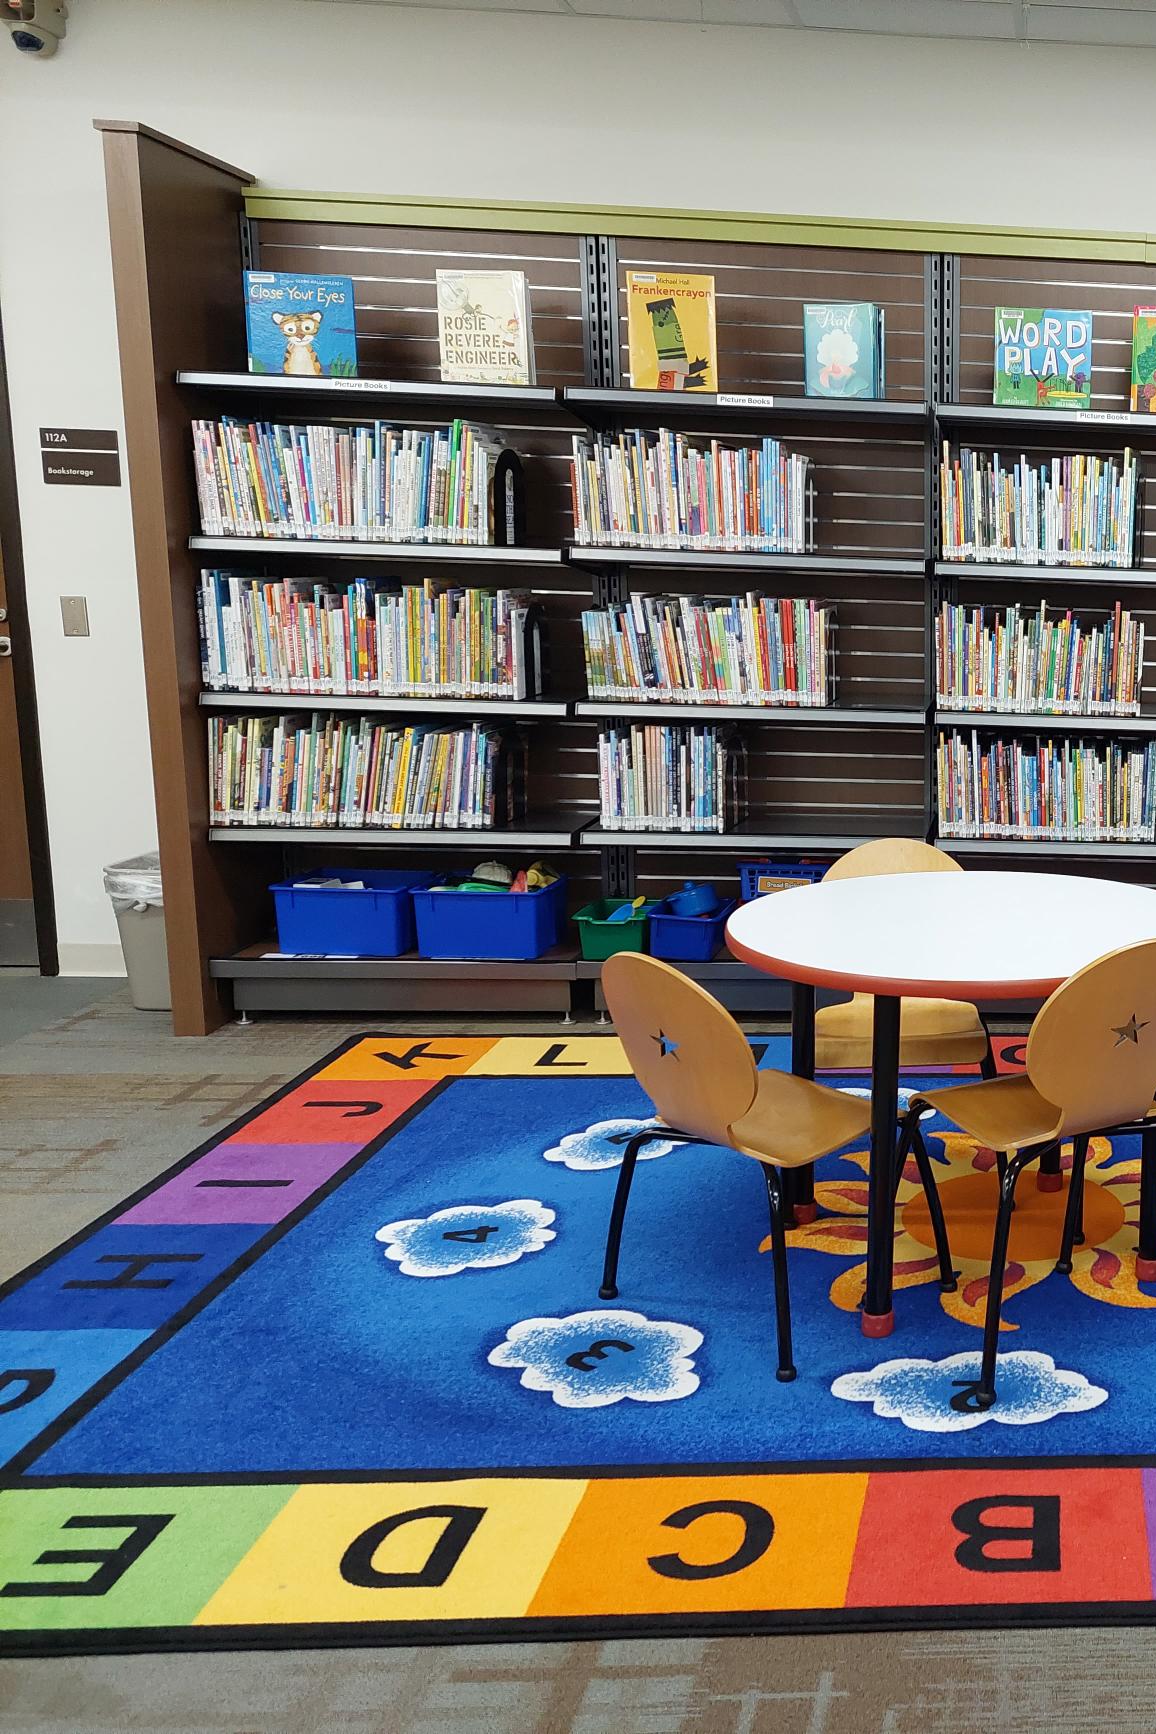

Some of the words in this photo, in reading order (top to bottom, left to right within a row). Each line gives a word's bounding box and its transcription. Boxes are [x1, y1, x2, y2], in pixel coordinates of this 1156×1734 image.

[250, 284, 283, 299] Close
[286, 286, 314, 301] Your
[317, 287, 345, 307] Eyes
[632, 284, 711, 299] Frankencrayon
[444, 316, 487, 331] ROSIE
[999, 318, 1087, 348] WORD
[446, 350, 518, 366] ENGINEER
[1004, 346, 1086, 381] PLAY
[1080, 412, 1105, 420] Picture
[45, 433, 68, 442] 112A
[47, 466, 94, 477] Bookstorage
[374, 1042, 466, 1069] K
[534, 1043, 588, 1067] L
[304, 1101, 383, 1117] J
[194, 1179, 294, 1188] I
[442, 1225, 500, 1243] 4
[61, 1253, 204, 1289] H
[566, 1340, 635, 1372] 3
[647, 1500, 775, 1580] C
[950, 1495, 1061, 1572] B
[1, 1514, 175, 1596] E
[339, 1504, 488, 1588] D
